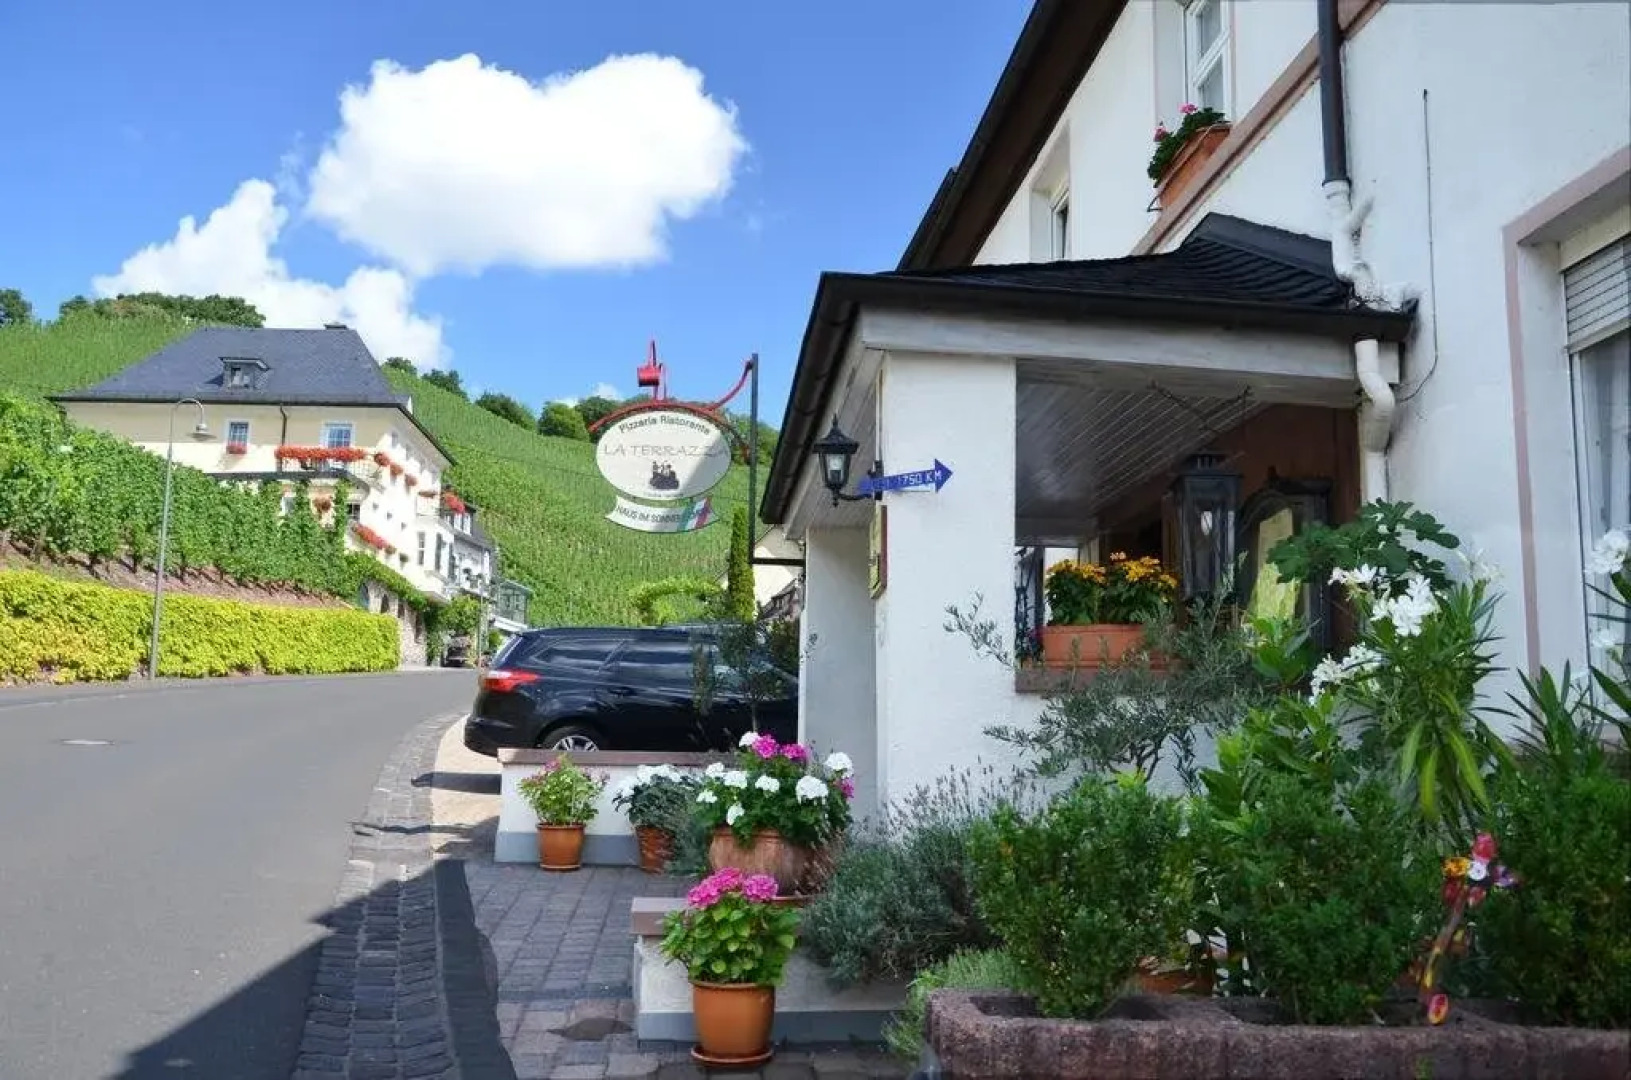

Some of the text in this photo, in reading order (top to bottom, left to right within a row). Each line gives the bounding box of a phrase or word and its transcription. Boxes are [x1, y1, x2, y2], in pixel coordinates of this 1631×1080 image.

[660, 415, 711, 436] Ristorante
[603, 444, 625, 457] LA
[925, 470, 942, 482] KM
